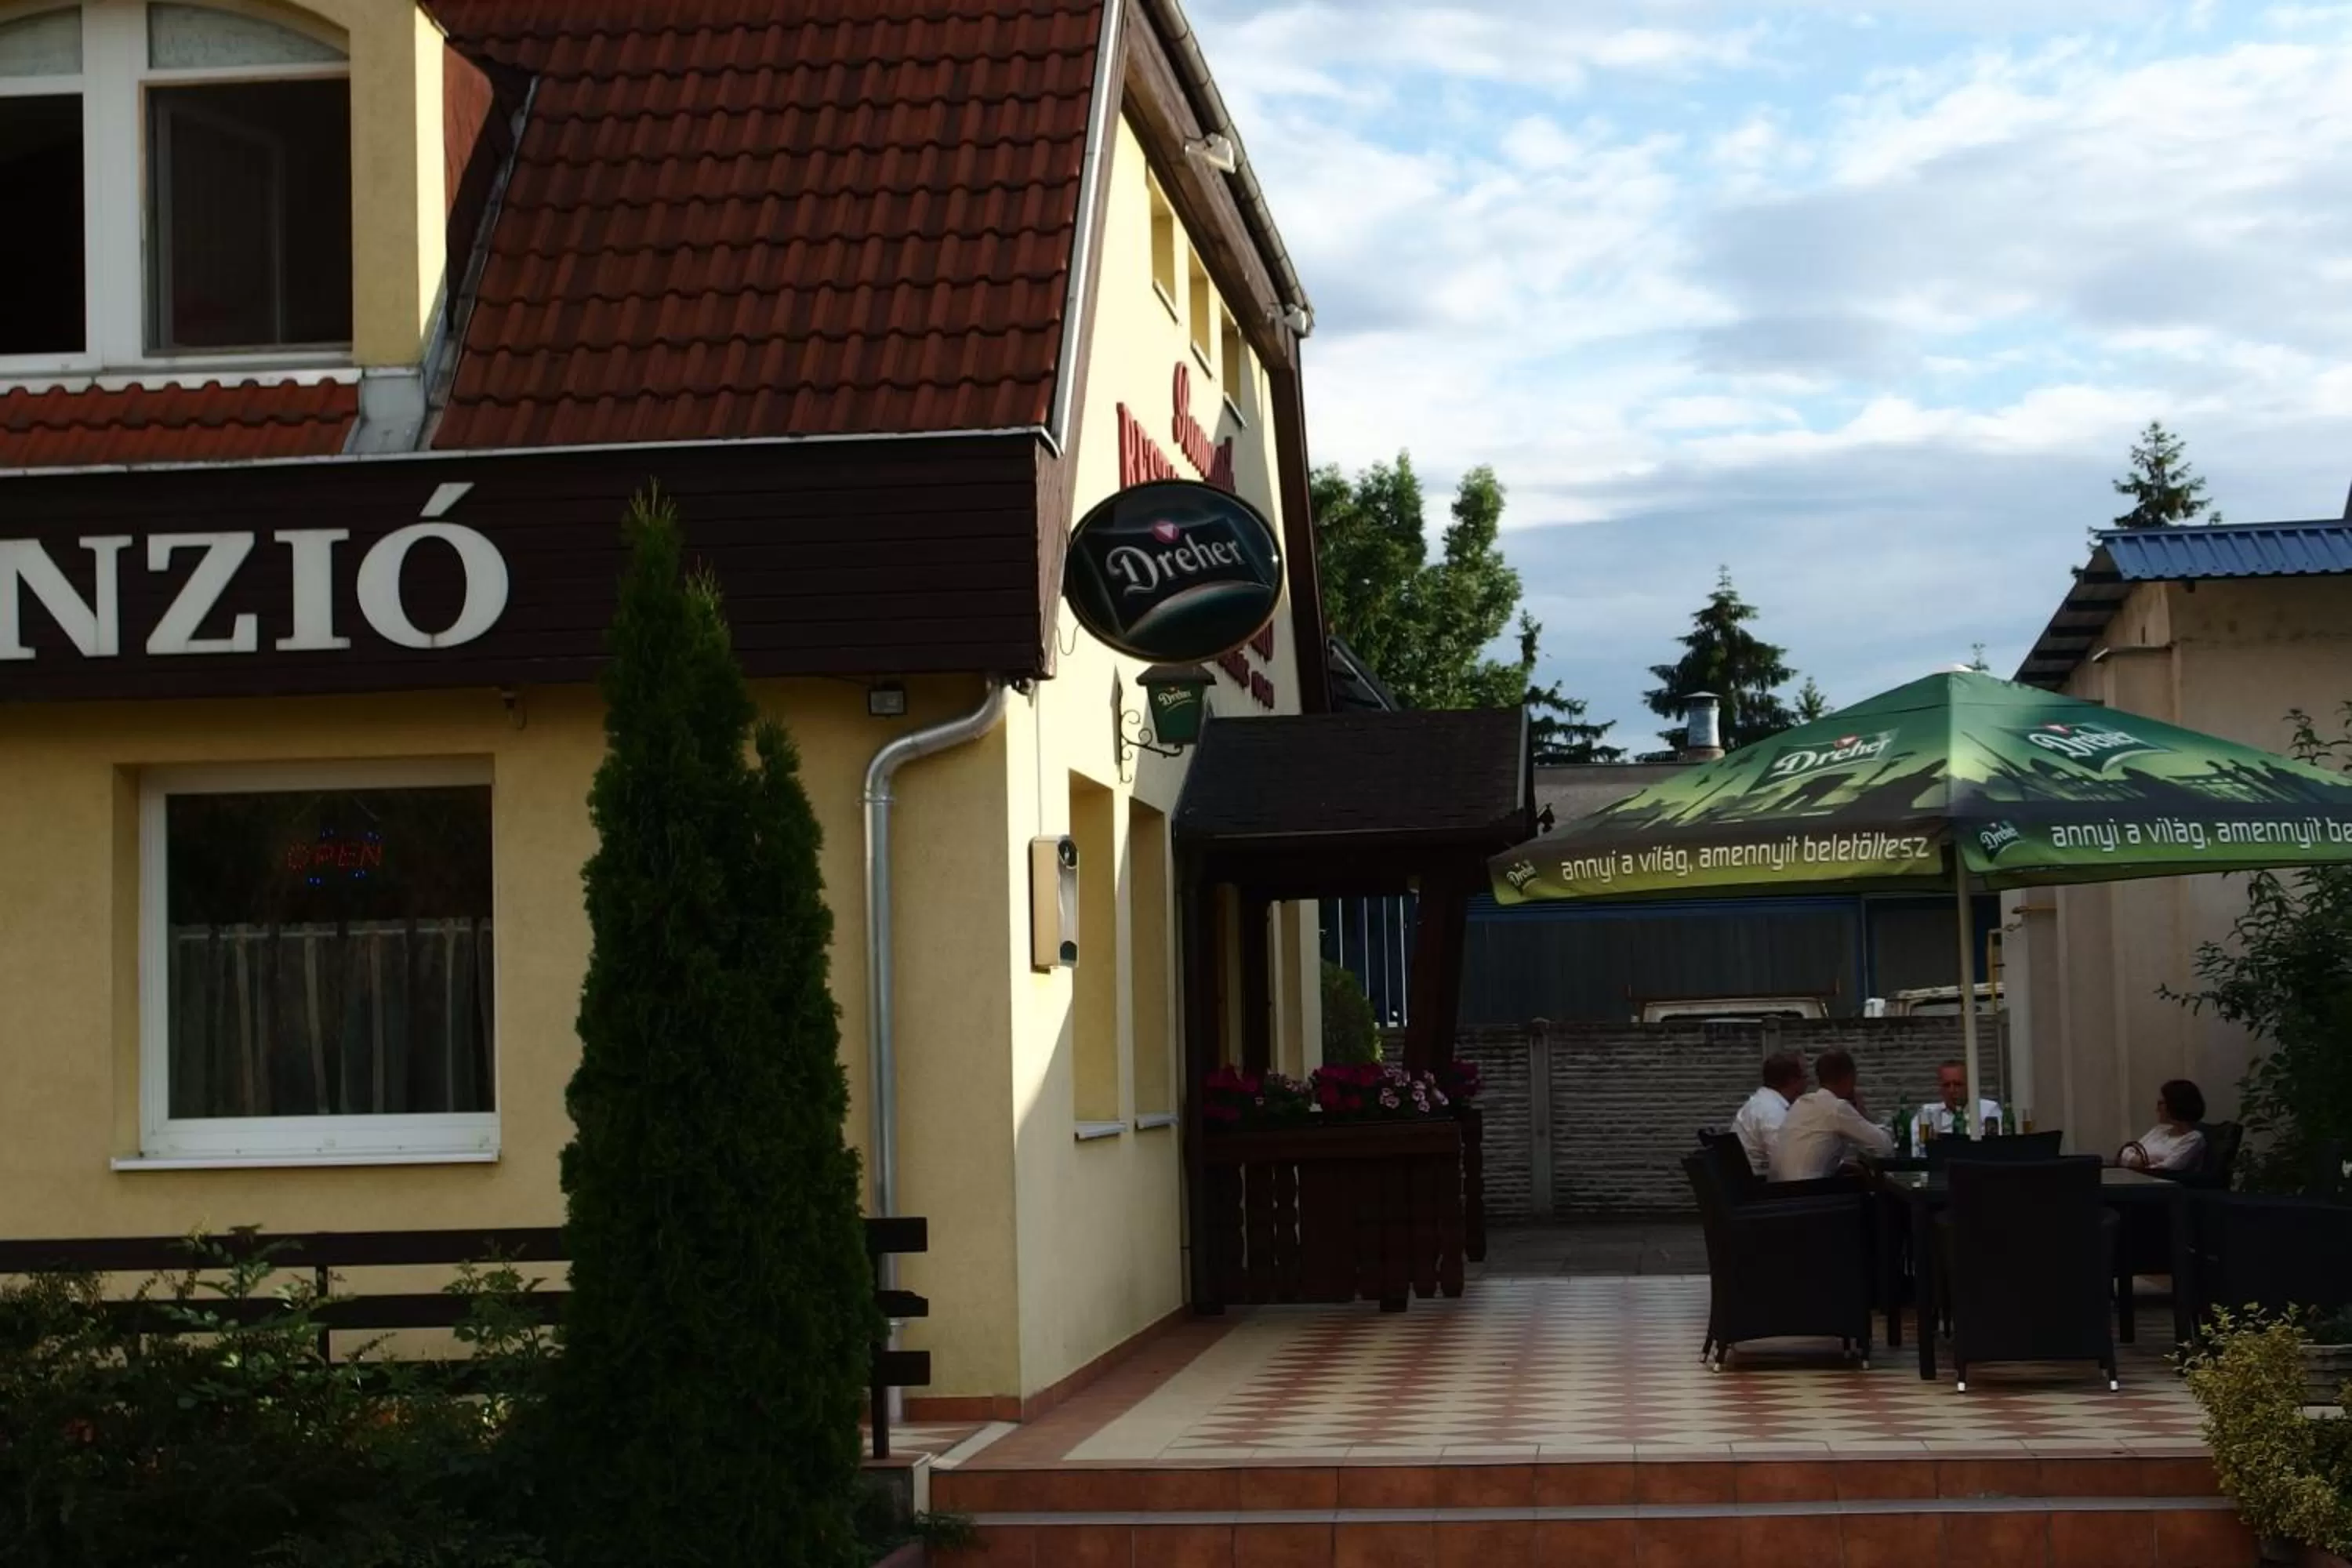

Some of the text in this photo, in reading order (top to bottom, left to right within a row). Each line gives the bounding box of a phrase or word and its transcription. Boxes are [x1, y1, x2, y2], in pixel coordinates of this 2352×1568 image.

[0, 482, 509, 659] NZIÓ
[1105, 533, 1244, 597] Dreher
[1769, 737, 1891, 778] Dreher
[1561, 832, 1929, 884] annyi a világ, amennyit beletöltesz
[2050, 818, 2119, 852] annyi
[2125, 823, 2140, 844] a
[2146, 818, 2211, 849] világ,
[2215, 816, 2321, 849] amennyit
